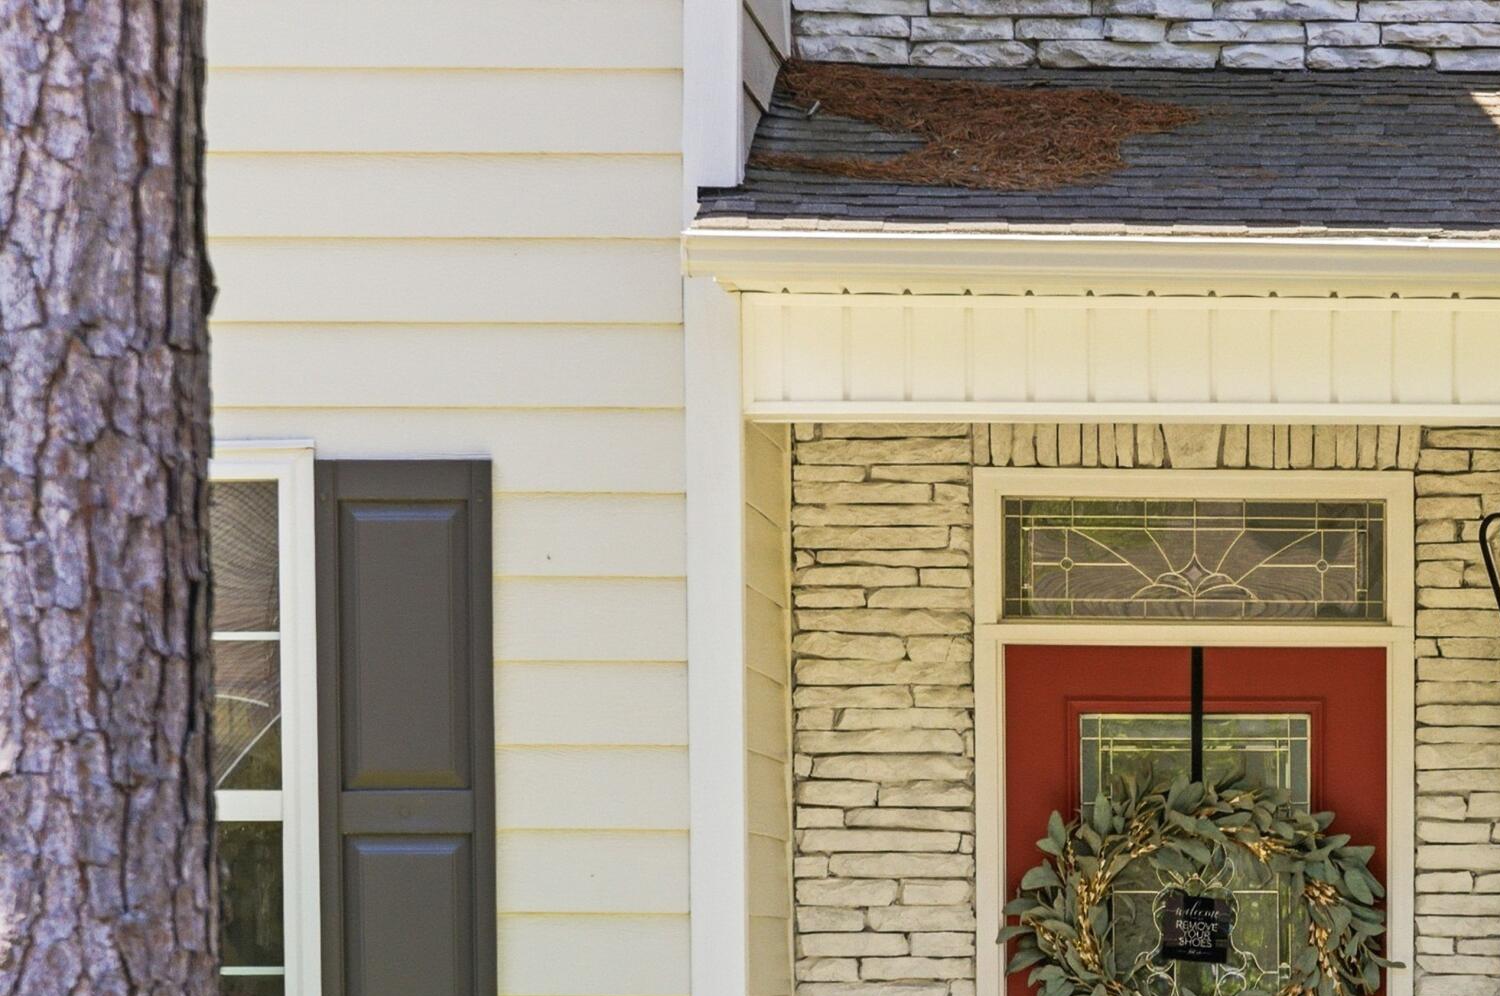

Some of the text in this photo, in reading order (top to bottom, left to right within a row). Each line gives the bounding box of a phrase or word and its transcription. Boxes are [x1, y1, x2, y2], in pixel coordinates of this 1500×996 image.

[1175, 919, 1218, 932] REMOVE
[1182, 928, 1212, 941] YOUR
[1178, 936, 1212, 948] SHOES
